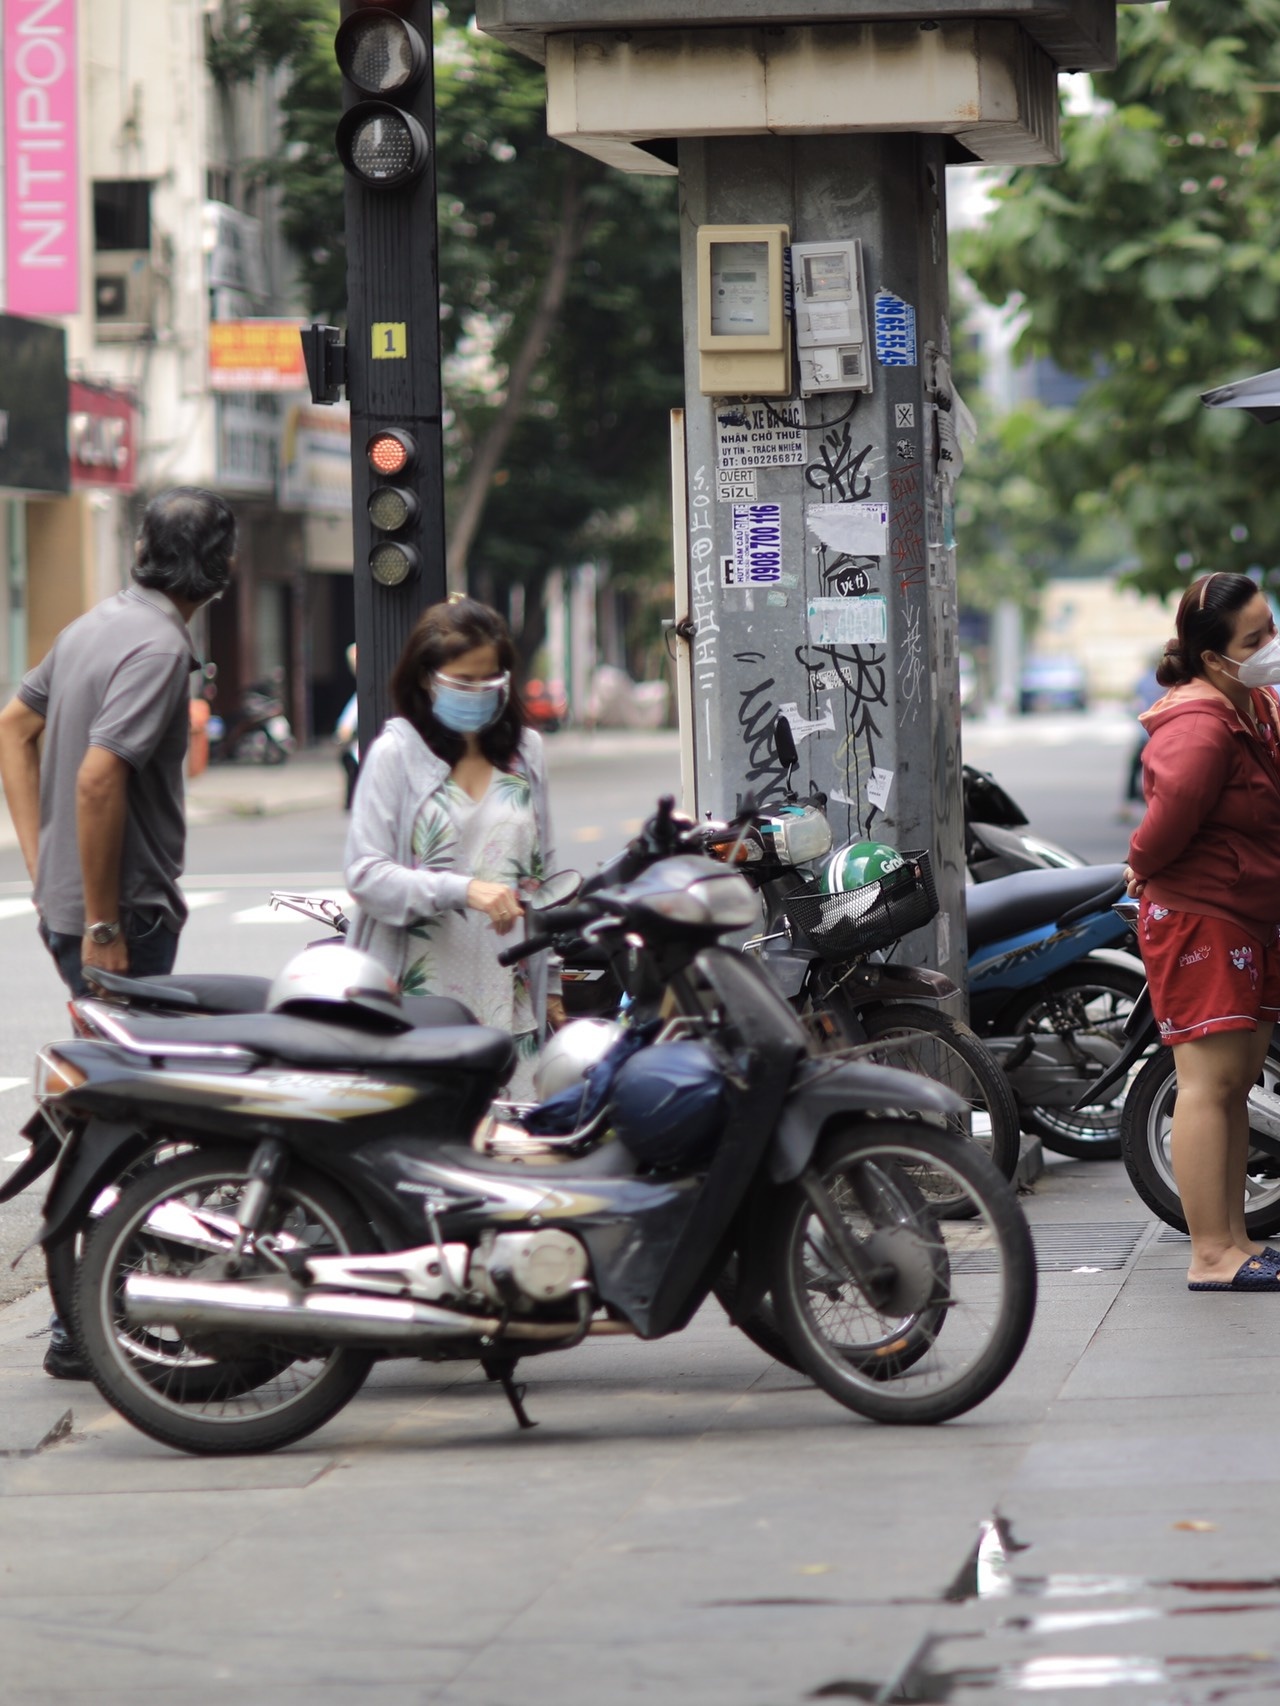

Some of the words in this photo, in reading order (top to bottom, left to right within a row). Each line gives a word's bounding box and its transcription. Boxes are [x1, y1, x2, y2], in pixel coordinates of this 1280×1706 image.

[384, 329, 396, 352] 1
[752, 410, 764, 429] XE
[722, 447, 732, 456] UY
[741, 453, 803, 466] 0902266872
[750, 505, 780, 582] 0908.700.116
